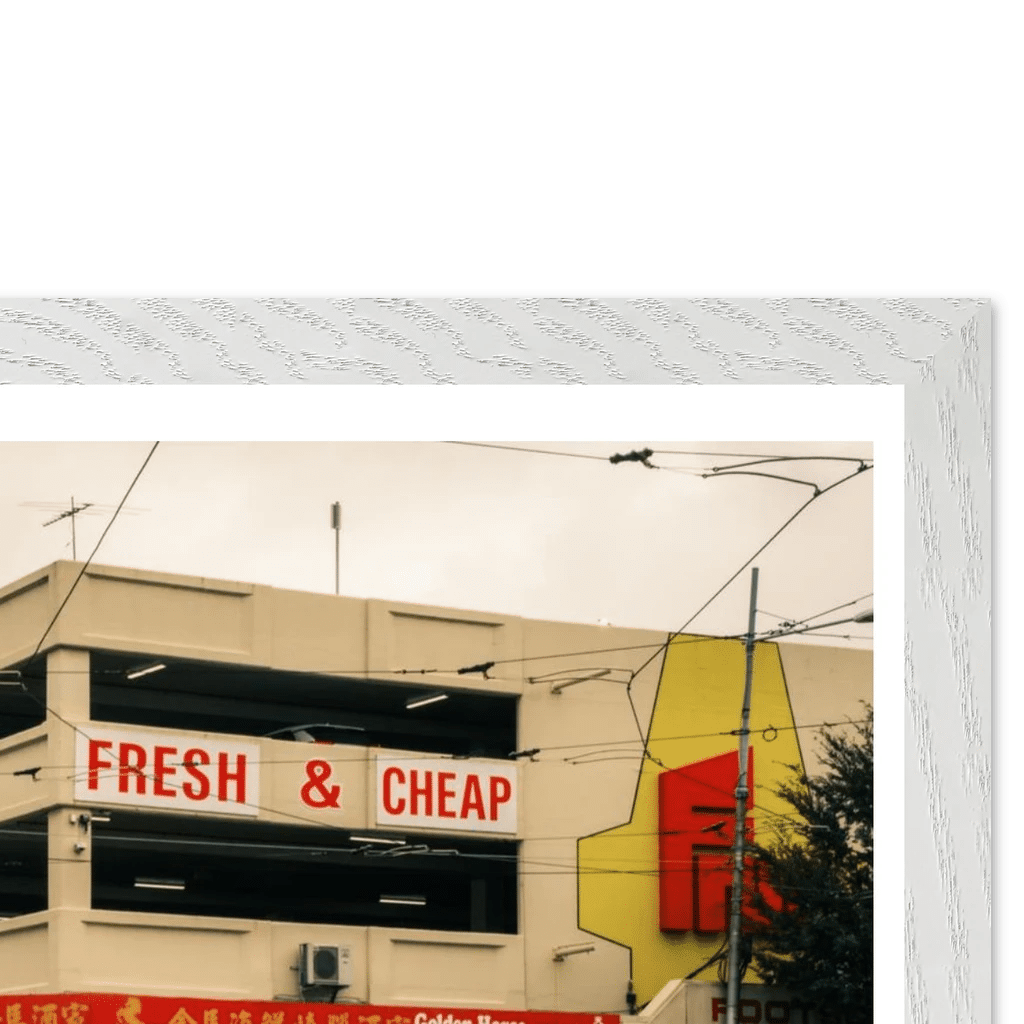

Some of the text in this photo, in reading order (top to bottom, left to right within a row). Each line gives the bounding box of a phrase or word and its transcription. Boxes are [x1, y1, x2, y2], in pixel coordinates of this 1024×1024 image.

[87, 739, 512, 822] FRESH & CHEAP
